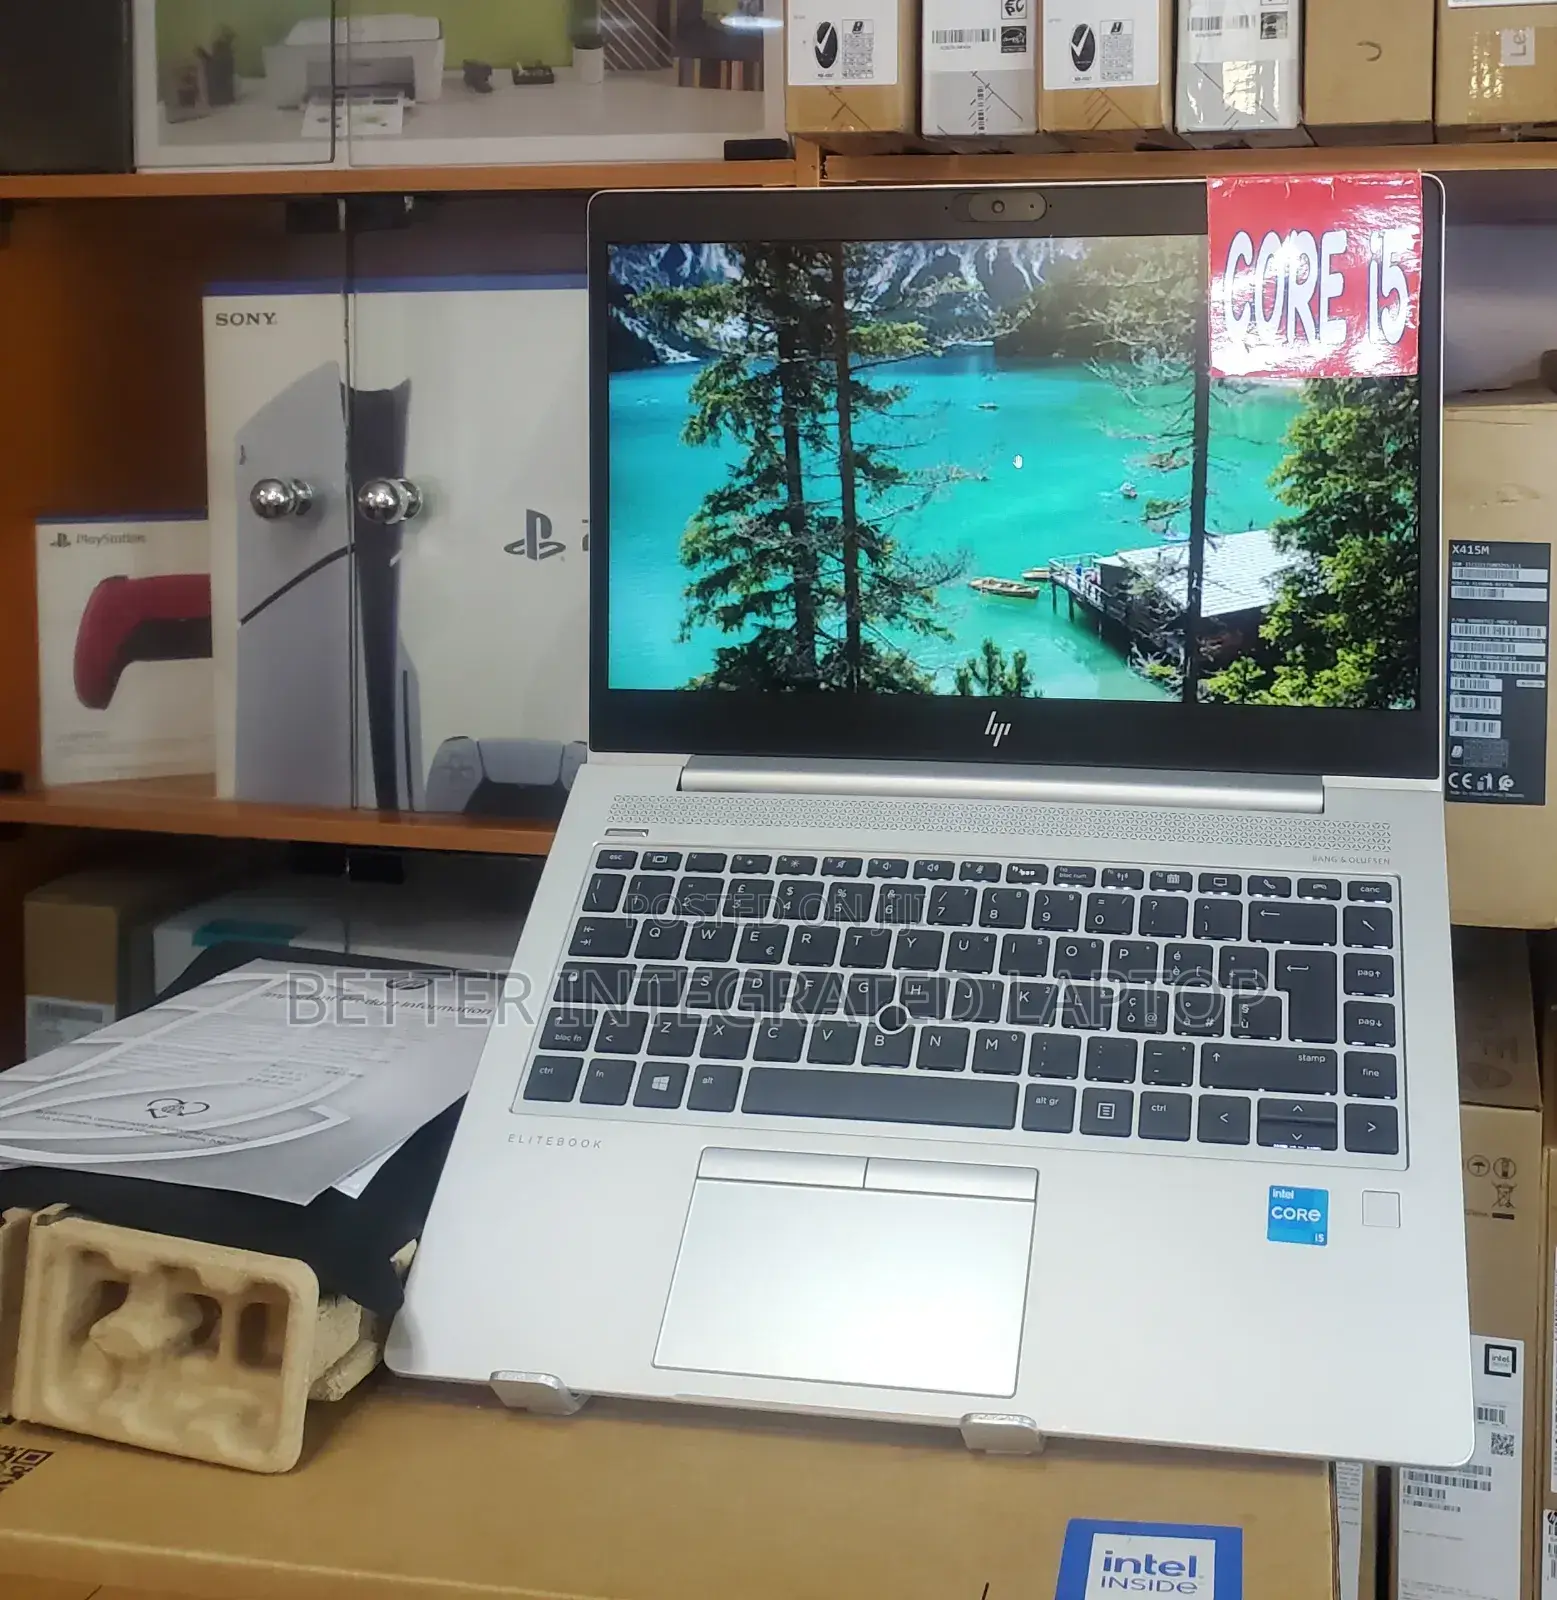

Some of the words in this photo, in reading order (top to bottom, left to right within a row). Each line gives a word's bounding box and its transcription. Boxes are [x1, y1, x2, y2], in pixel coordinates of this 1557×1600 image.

[1224, 229, 1347, 345] CORE
[215, 312, 277, 327] SONY
[1451, 544, 1490, 555] X415M
[985, 711, 1011, 747] hp
[1313, 855, 1338, 863] BANG
[1341, 856, 1346, 864] &
[1349, 857, 1390, 865] OLUFSEN
[786, 886, 794, 896] $
[1360, 885, 1380, 893] canc
[783, 902, 791, 911] 4
[885, 904, 893, 915] 6
[937, 907, 946, 916] 7
[989, 910, 998, 919] 8
[1042, 912, 1051, 922] 9
[649, 928, 660, 938] Q
[701, 929, 717, 940] W
[750, 931, 760, 942] E
[801, 933, 812, 944] R
[853, 935, 863, 946] T
[907, 937, 917, 949] Y
[959, 939, 969, 951] U
[1119, 949, 1129, 959] P
[648, 974, 660, 984] A
[1357, 969, 1374, 978] pag
[700, 976, 710, 987] S
[752, 978, 763, 989] D
[804, 979, 814, 990] F
[858, 981, 869, 993] G
[910, 984, 921, 995] H
[964, 987, 972, 999] J
[1019, 991, 1030, 1002] K
[401, 1001, 493, 1015] Information
[660, 1022, 672, 1033] Z
[1358, 1018, 1375, 1027] pag
[713, 1025, 725, 1036] X
[768, 1028, 779, 1039] C
[822, 1030, 834, 1041] V
[554, 1033, 572, 1042] bloc
[573, 1034, 582, 1042] fn
[874, 1035, 885, 1046] B
[930, 1035, 941, 1047] N
[986, 1038, 998, 1050] M
[1298, 1054, 1326, 1063] stamp
[539, 1067, 553, 1075] ctrl
[596, 1070, 604, 1078] fn
[1362, 1068, 1380, 1077] fine
[1035, 1096, 1047, 1104] alt
[1049, 1098, 1059, 1106] gr
[1151, 1103, 1166, 1112] ctrl
[508, 1133, 603, 1149] ELITEBOOK
[1272, 1188, 1295, 1200] intel
[1103, 1550, 1198, 1579] intel
